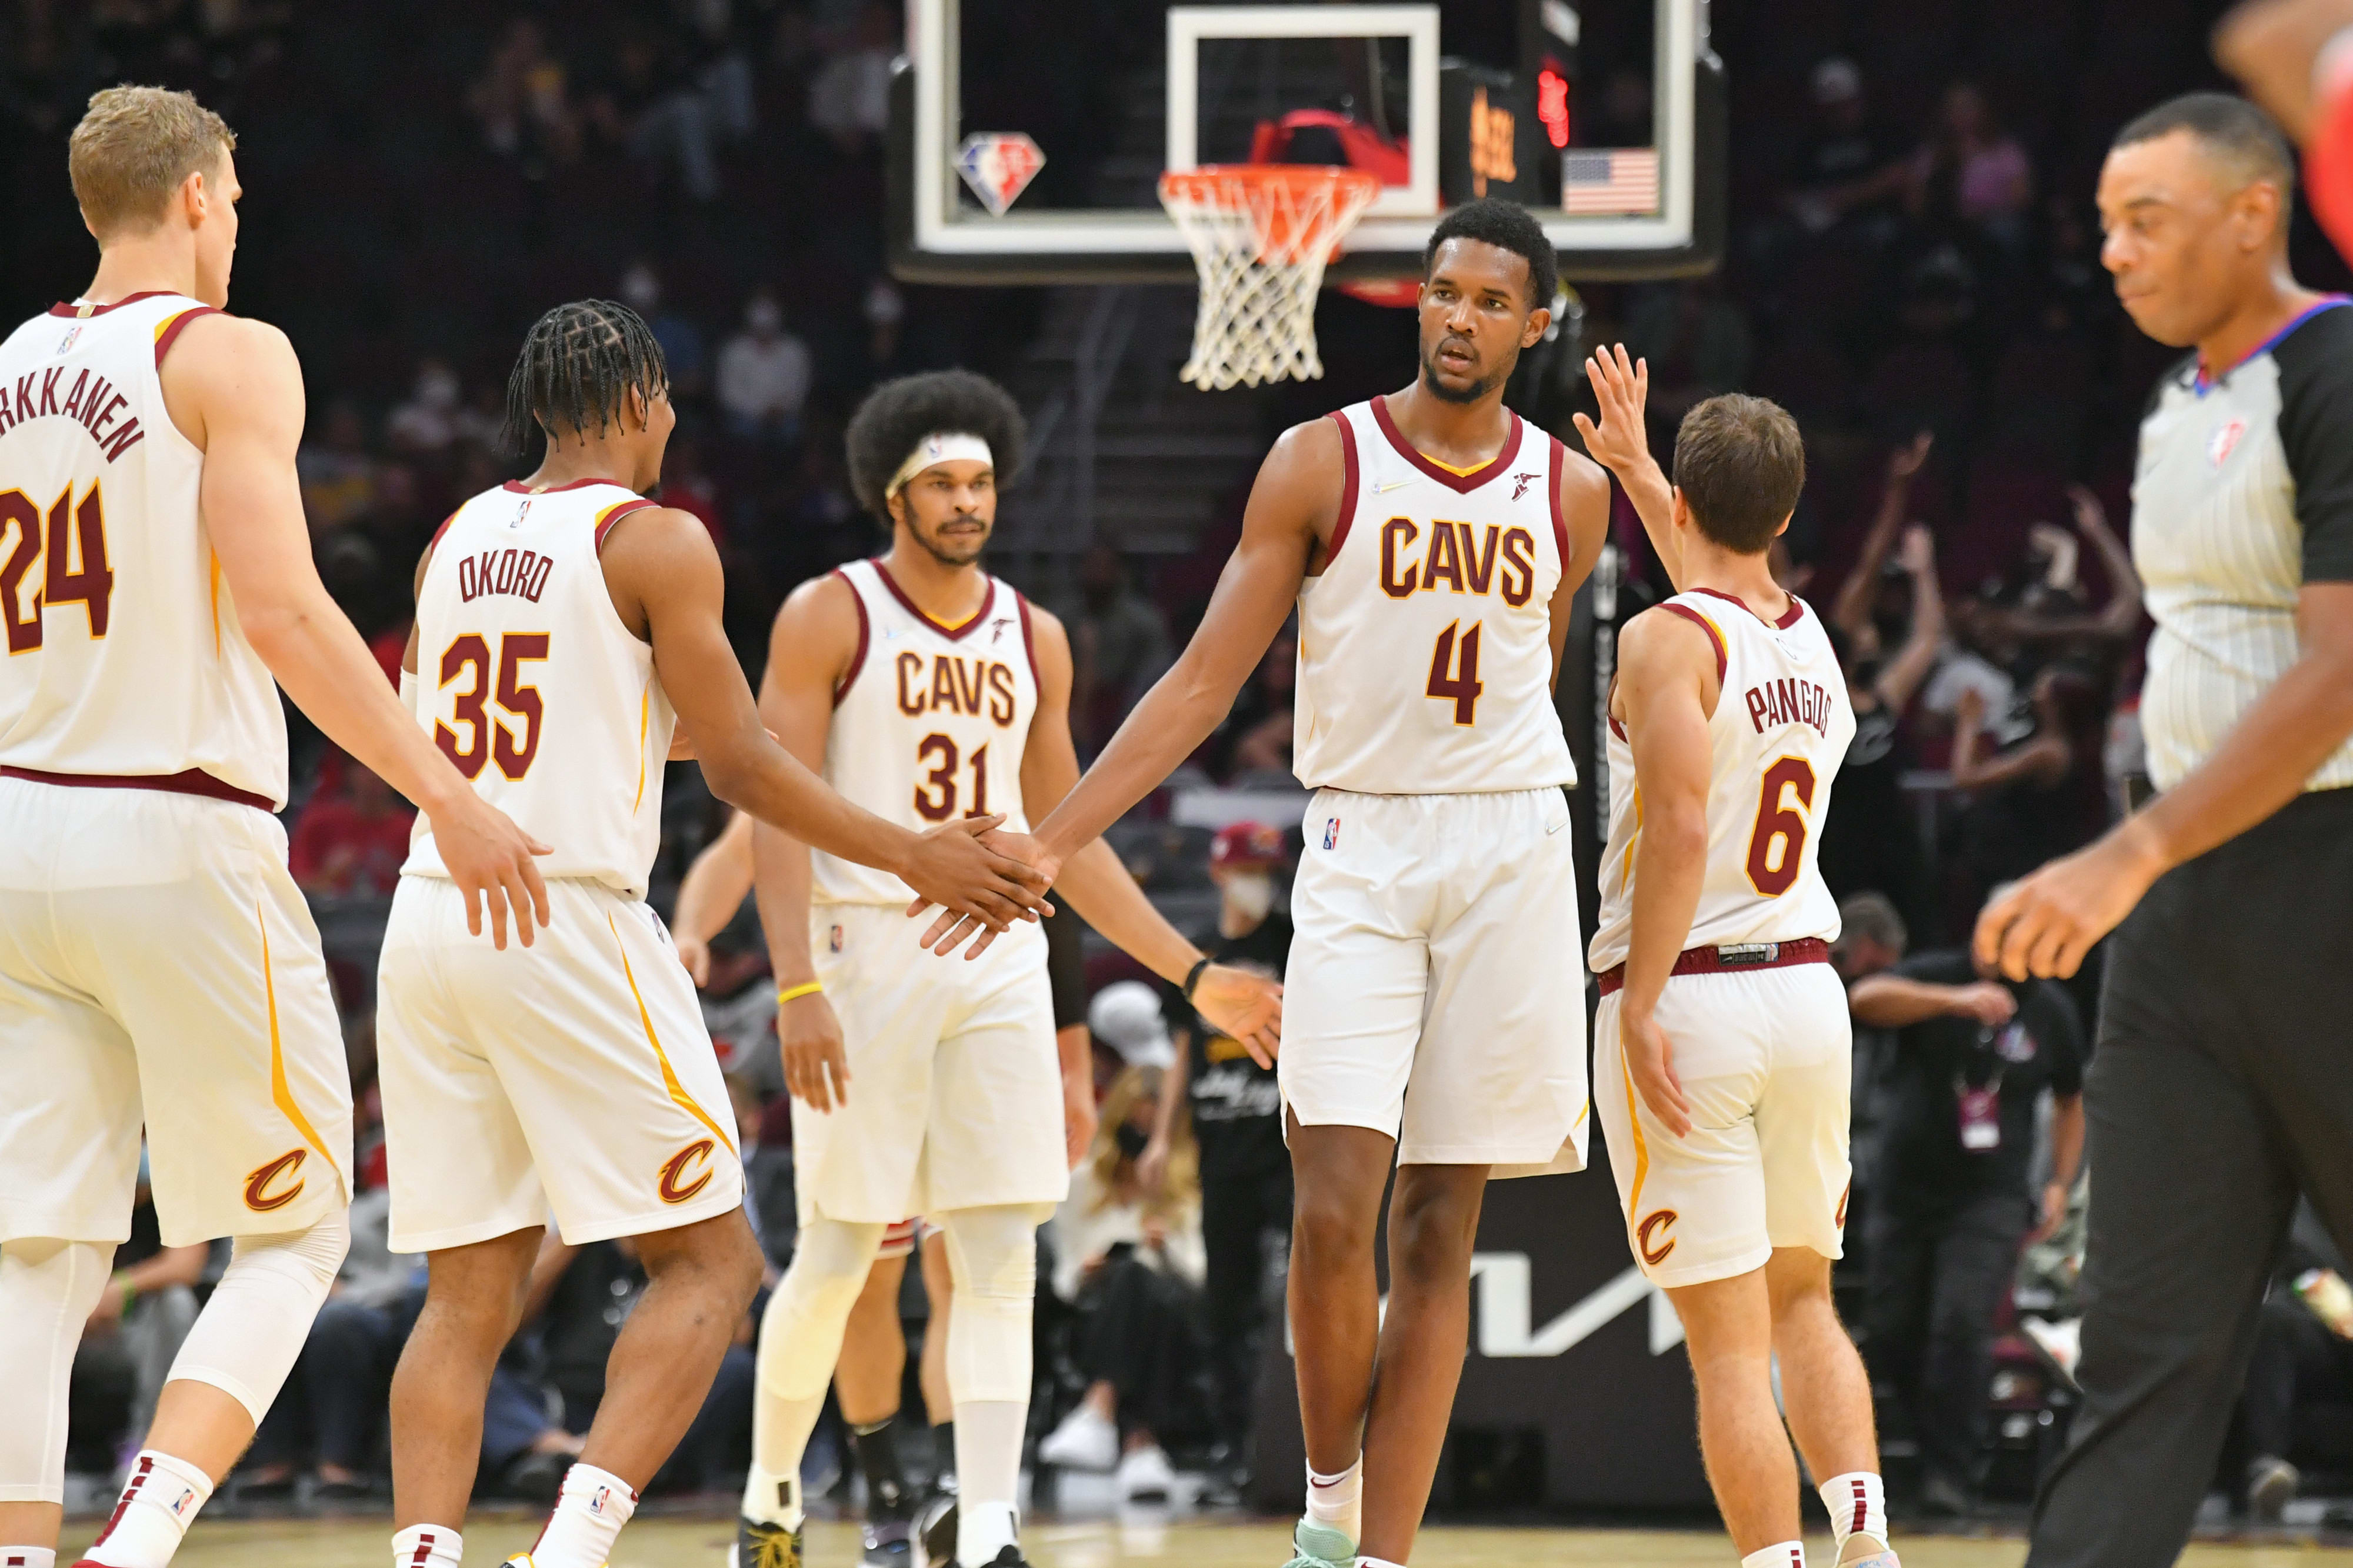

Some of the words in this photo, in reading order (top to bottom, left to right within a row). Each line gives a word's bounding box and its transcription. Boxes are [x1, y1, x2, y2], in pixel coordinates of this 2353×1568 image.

[0, 476, 114, 656] 24
[459, 549, 554, 603] OKORO
[1379, 516, 1535, 609] CAVS
[433, 632, 550, 782] 35
[896, 651, 1014, 728] CAVS
[1425, 618, 1484, 727] 4
[1745, 678, 1831, 739] PANGOS
[914, 732, 994, 823] 31
[1745, 754, 1816, 898] 6
